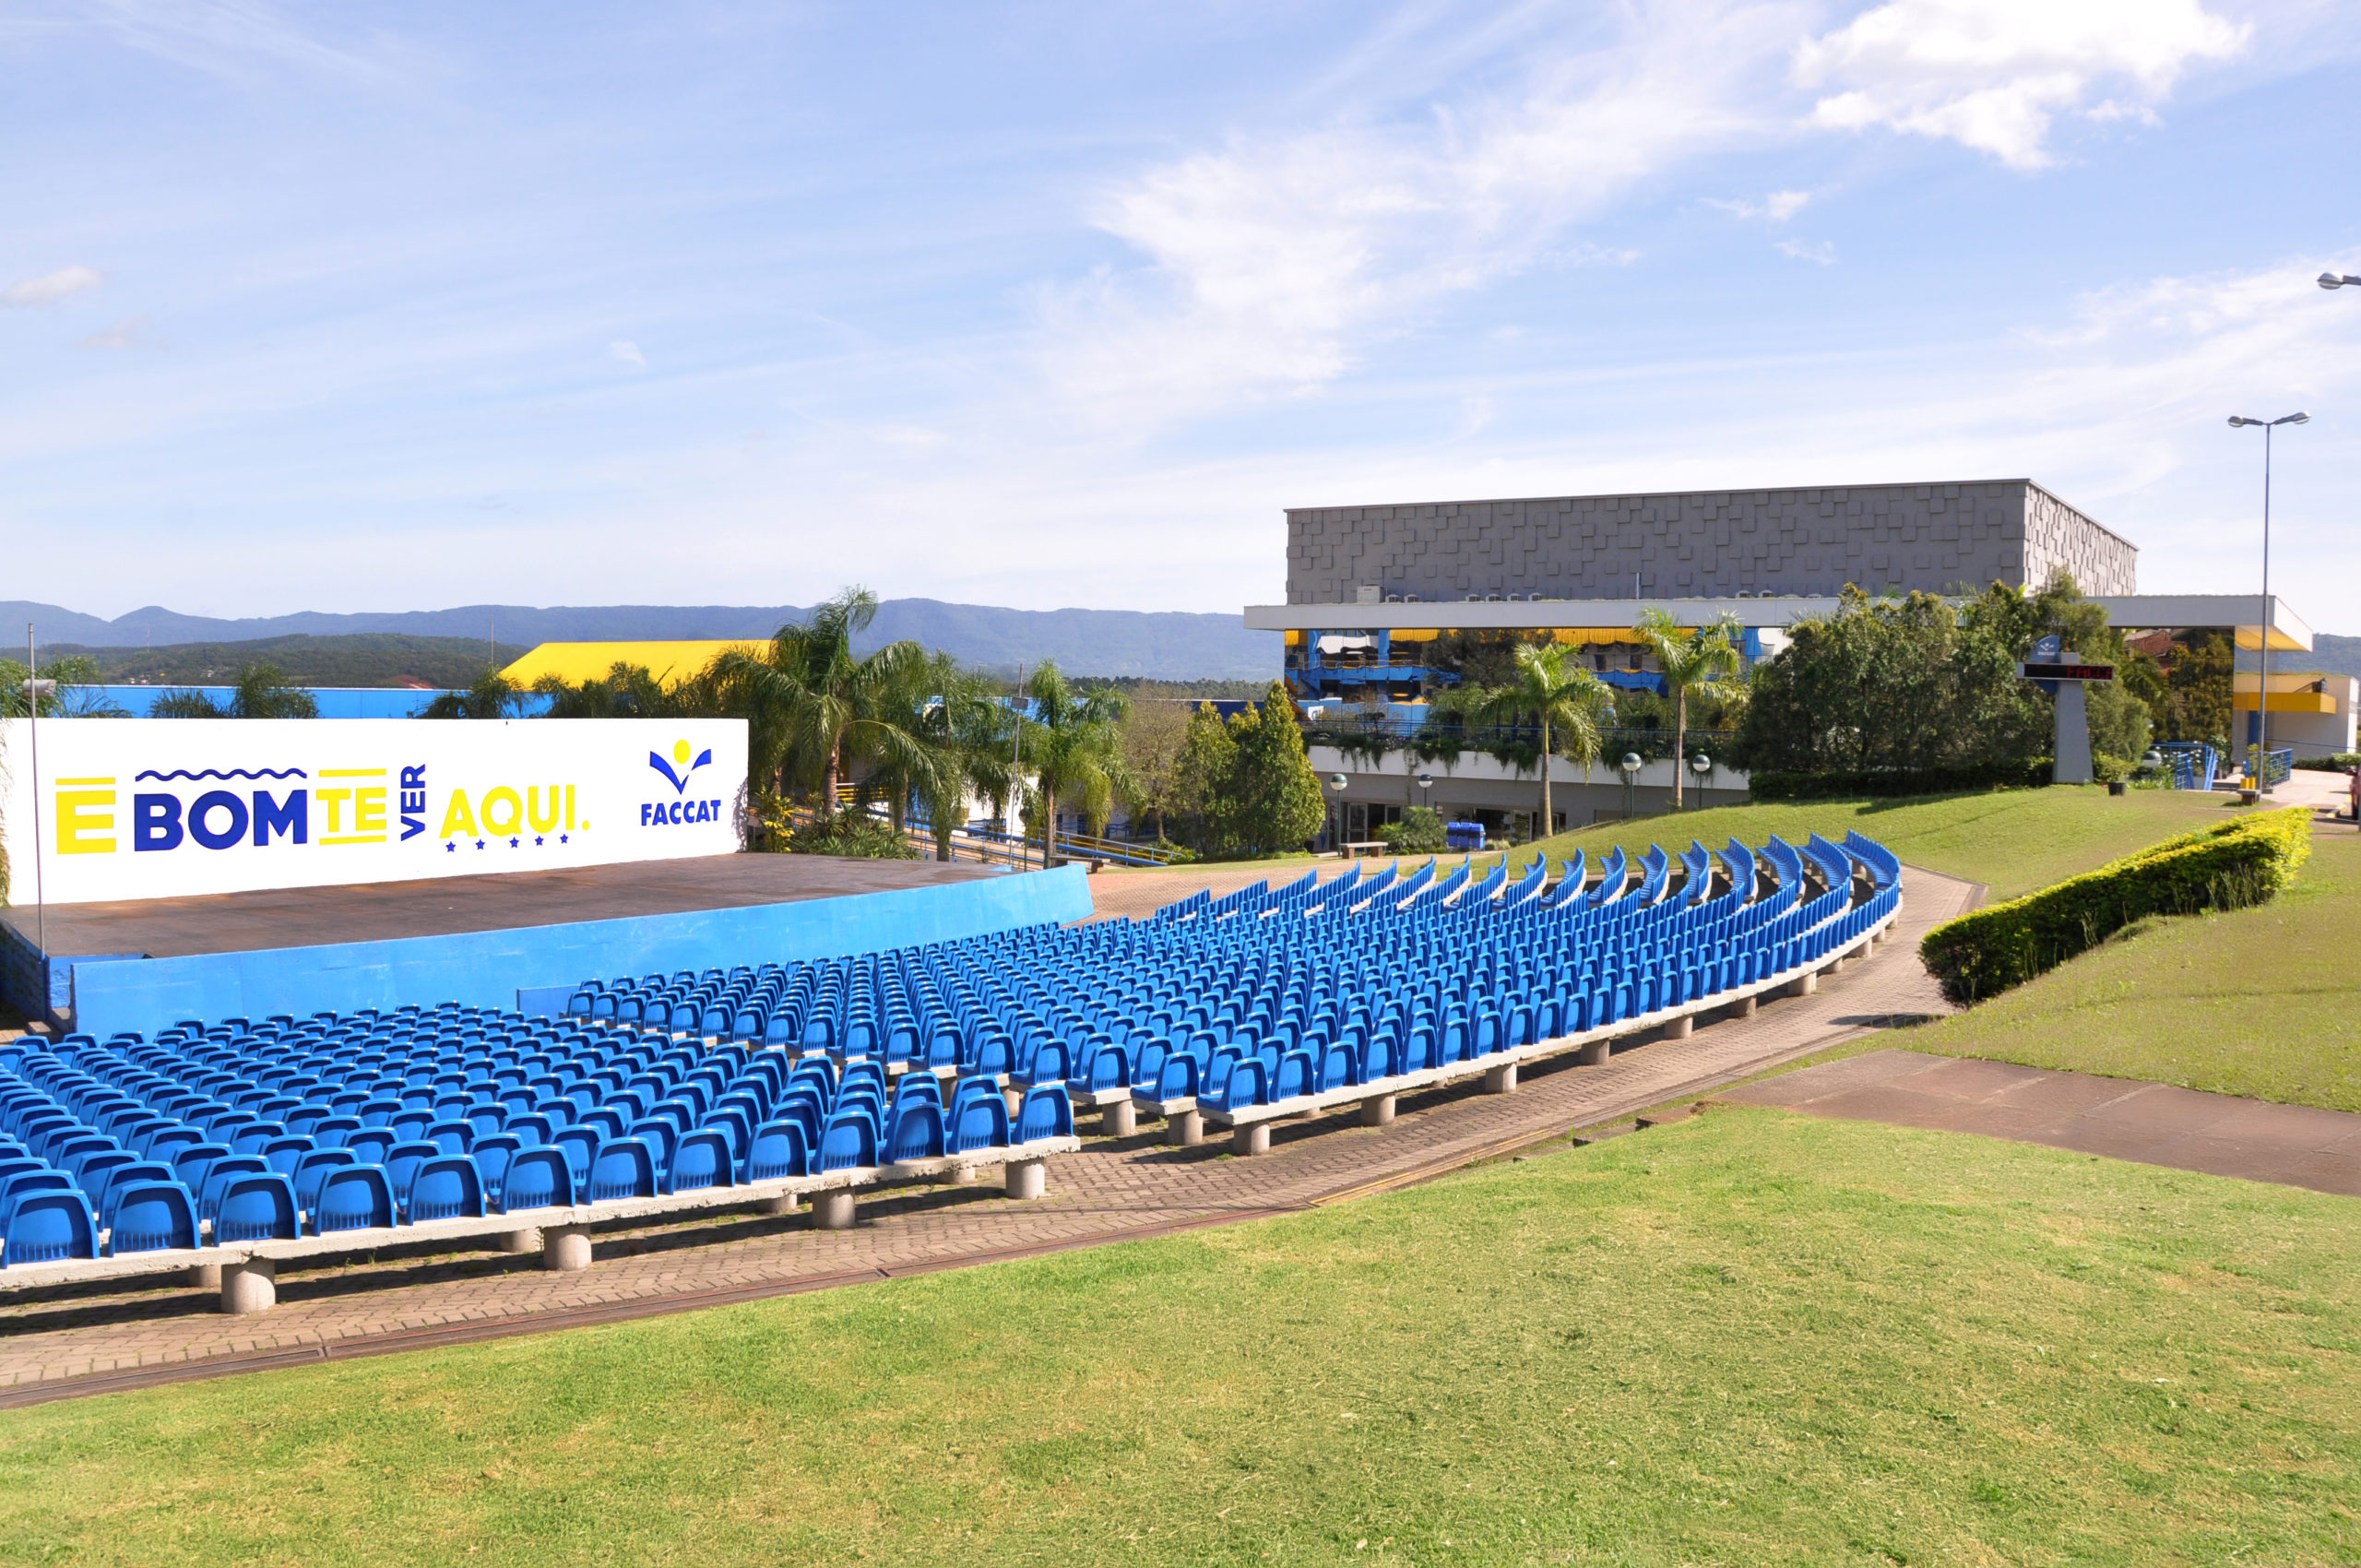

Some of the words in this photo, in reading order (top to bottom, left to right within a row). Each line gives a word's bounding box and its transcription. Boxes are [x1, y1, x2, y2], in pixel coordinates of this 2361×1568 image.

[134, 790, 308, 851] BOM
[316, 788, 387, 832] TE
[400, 764, 426, 842] VER
[439, 784, 591, 838] AQUI.
[641, 799, 722, 826] FACCAT
